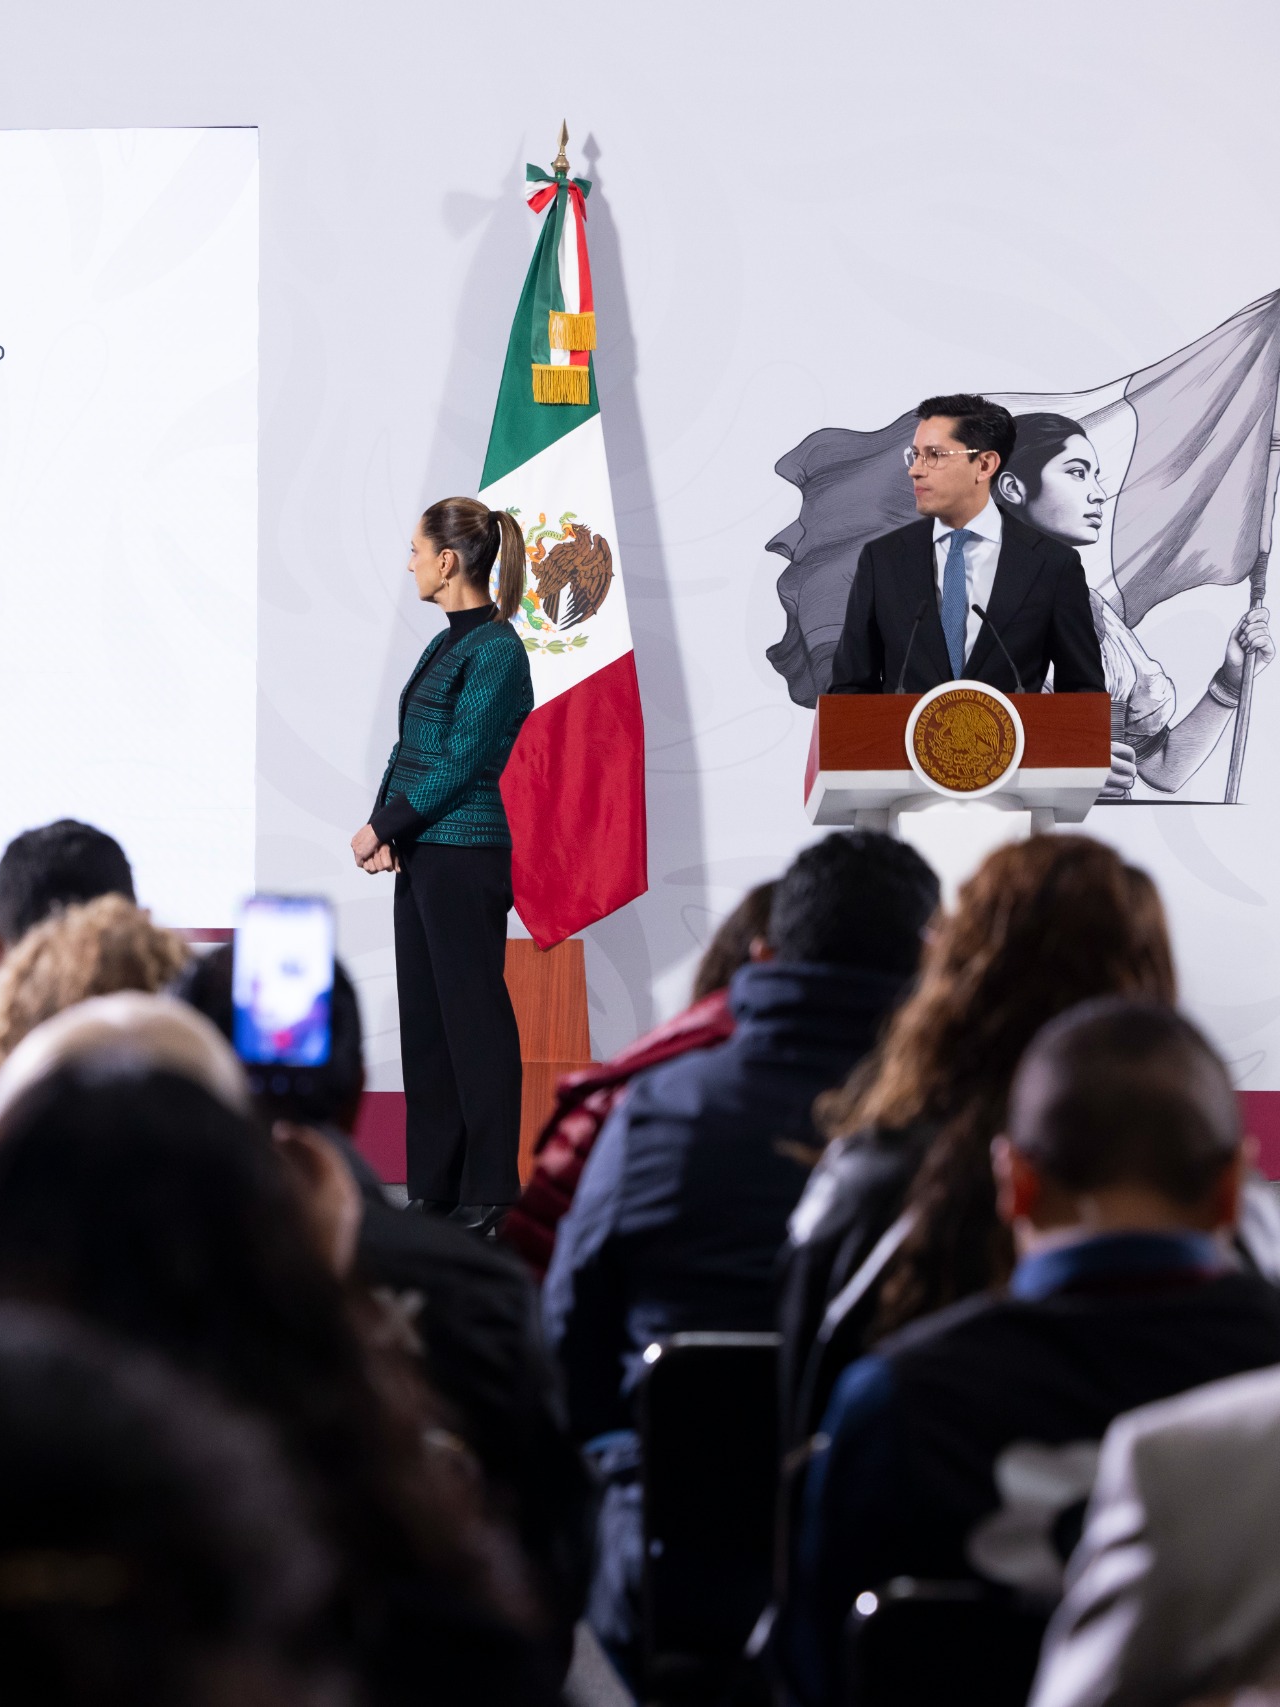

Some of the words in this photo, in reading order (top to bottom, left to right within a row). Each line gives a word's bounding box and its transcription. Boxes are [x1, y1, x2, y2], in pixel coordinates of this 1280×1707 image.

[915, 699, 941, 741] ESTADOS
[940, 690, 974, 704] UNIDOS
[976, 692, 1014, 741] MEXICANOS
